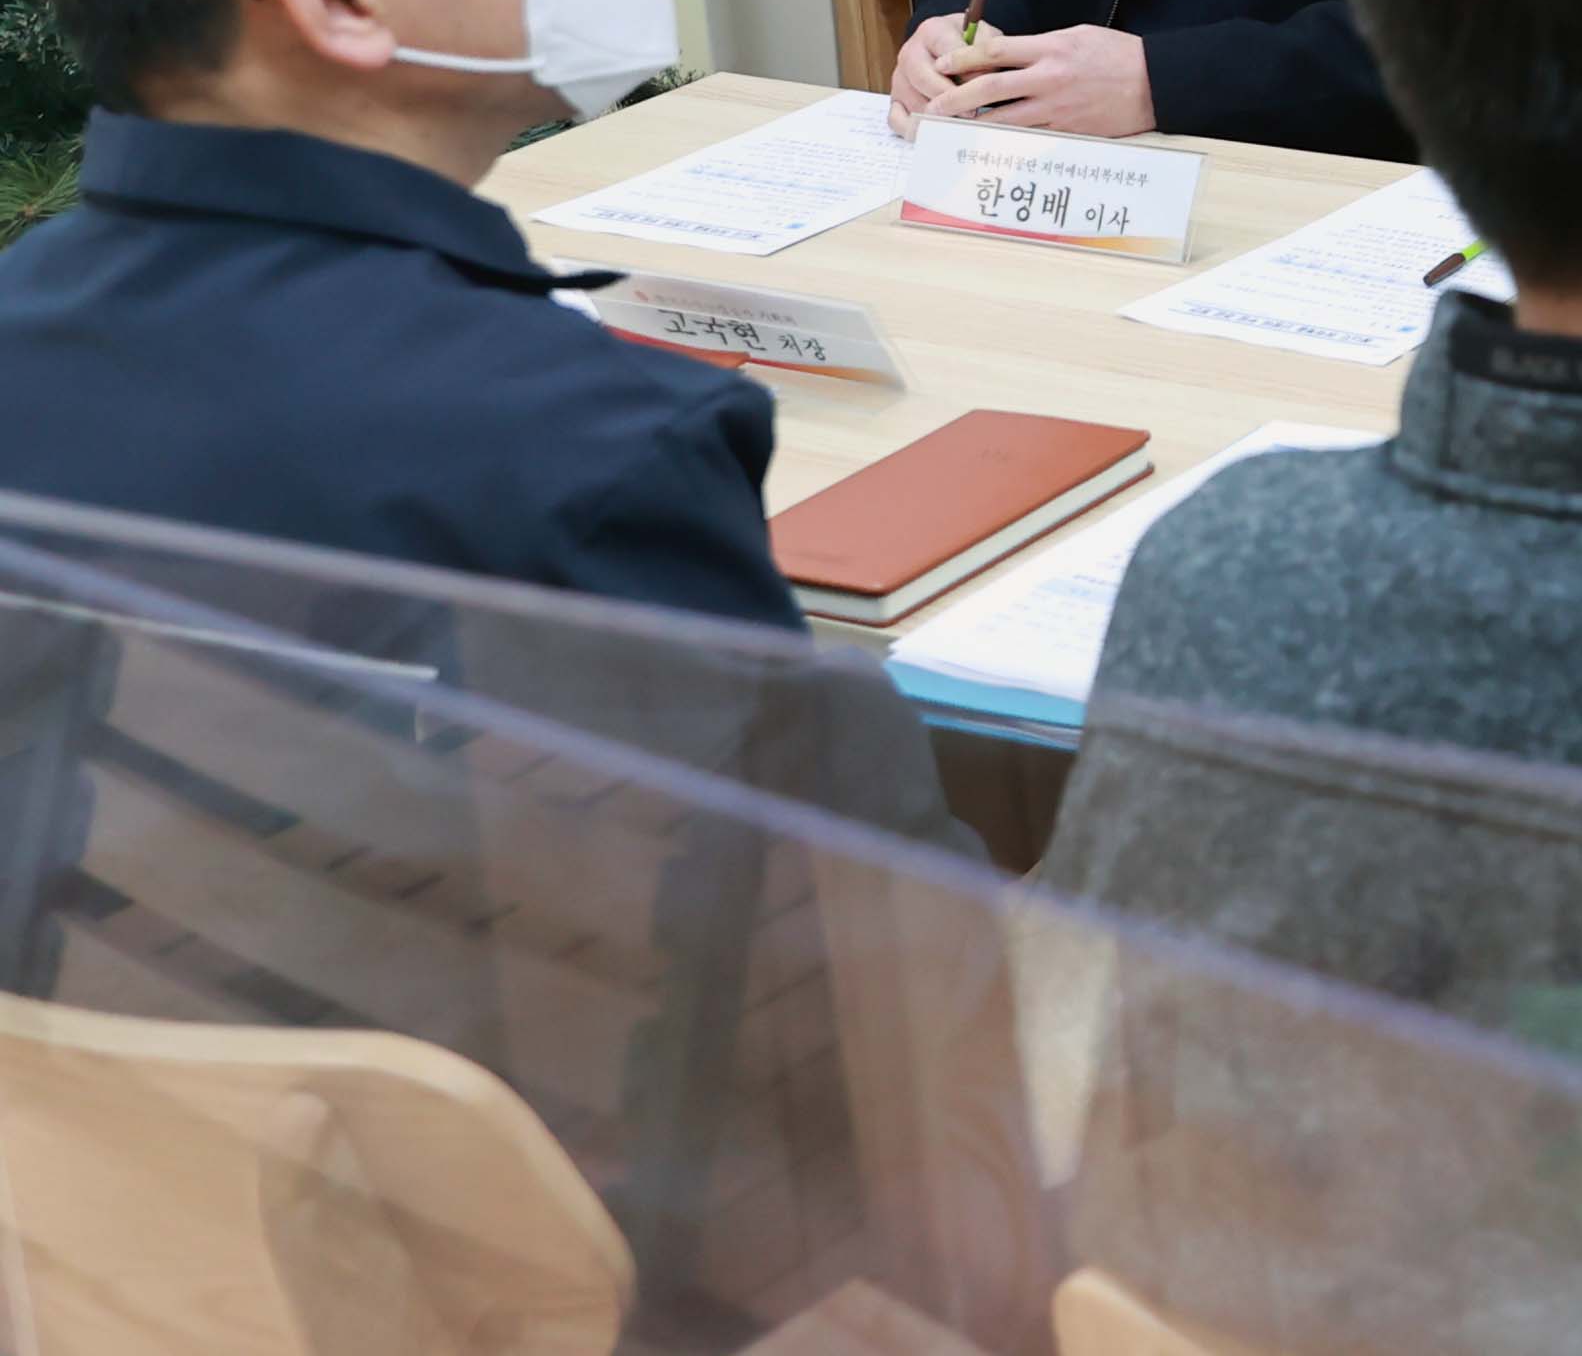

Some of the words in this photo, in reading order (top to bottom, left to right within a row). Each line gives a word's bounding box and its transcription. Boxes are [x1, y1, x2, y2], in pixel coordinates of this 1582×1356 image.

[957, 148, 1037, 173] 한국에너지공단
[1040, 159, 1149, 188] 지역에너지복지본부
[976, 176, 1071, 228] 한영배
[1085, 204, 1131, 235] 이사
